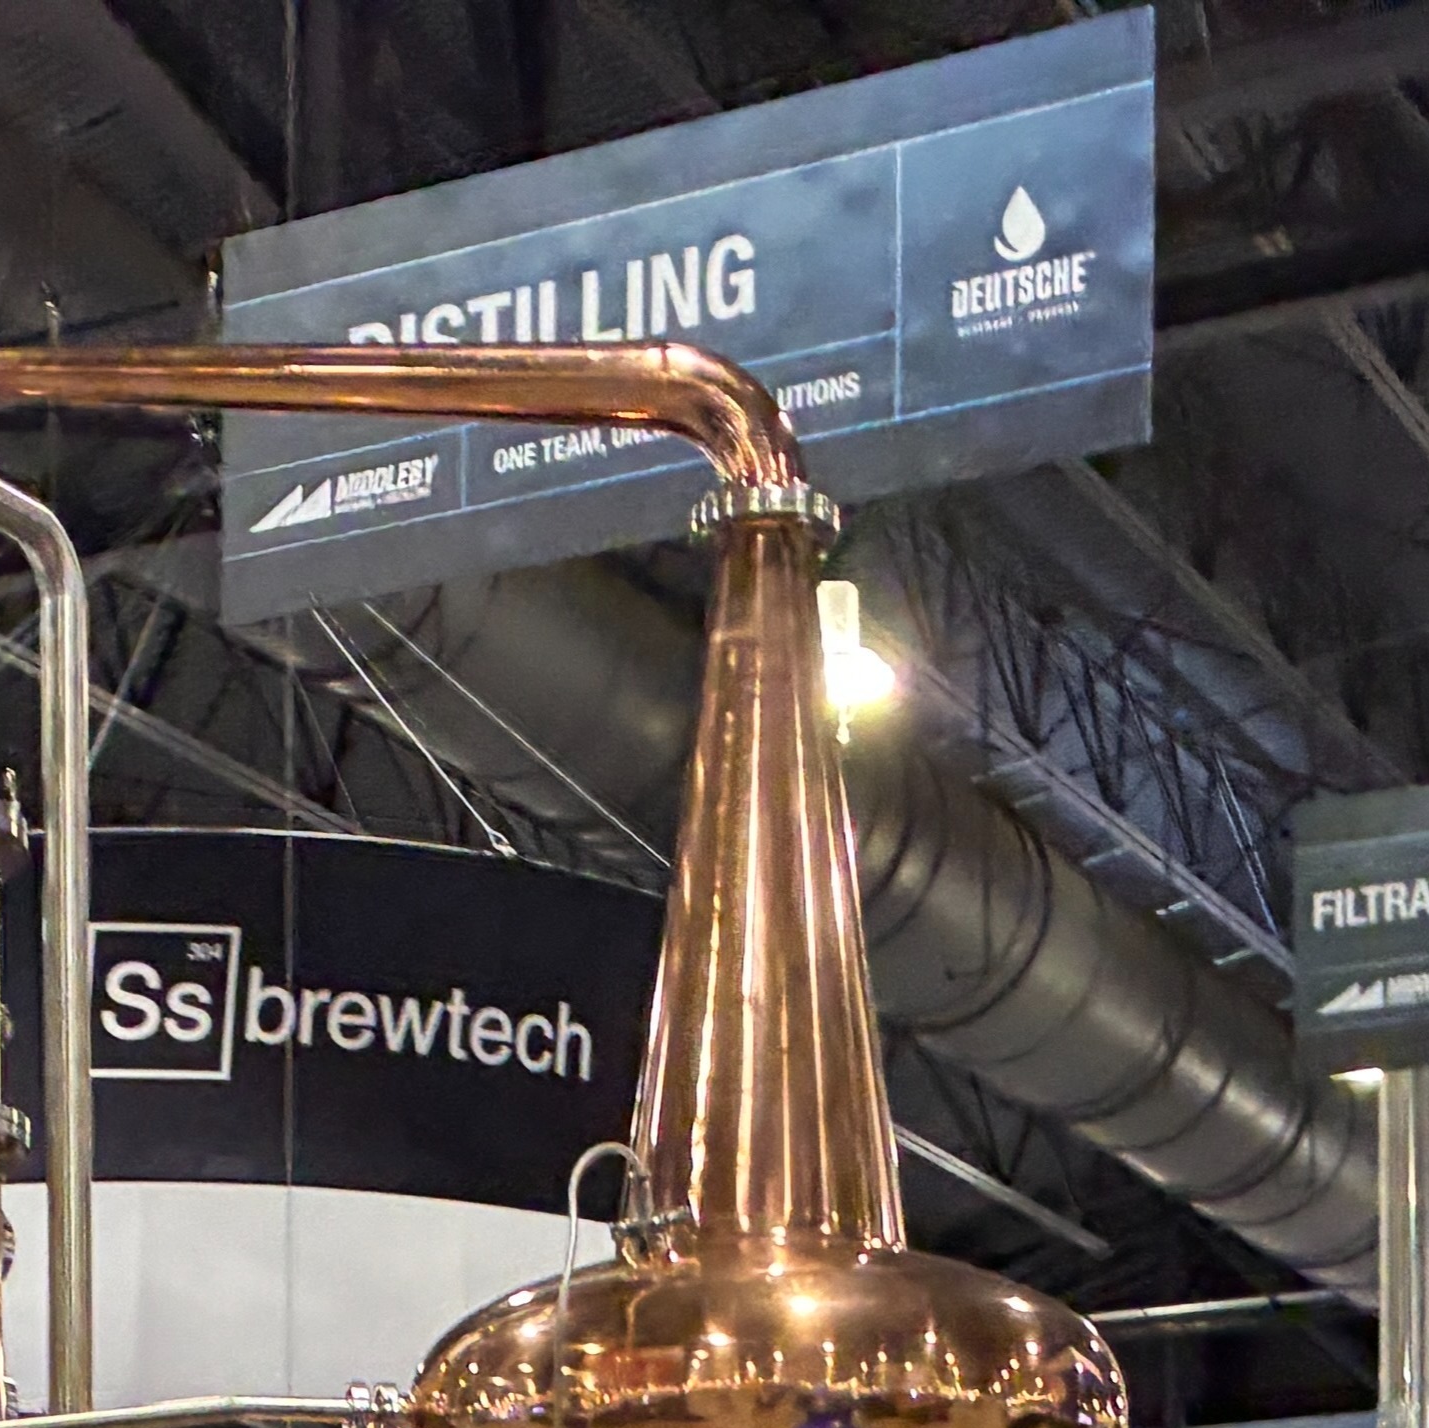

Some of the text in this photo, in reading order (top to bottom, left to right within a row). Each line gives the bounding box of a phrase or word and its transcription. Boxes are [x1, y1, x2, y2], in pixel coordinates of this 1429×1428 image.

[493, 442, 537, 474] ONE
[541, 427, 607, 463] TEAM,
[101, 960, 592, 1082] Ss brewtech
